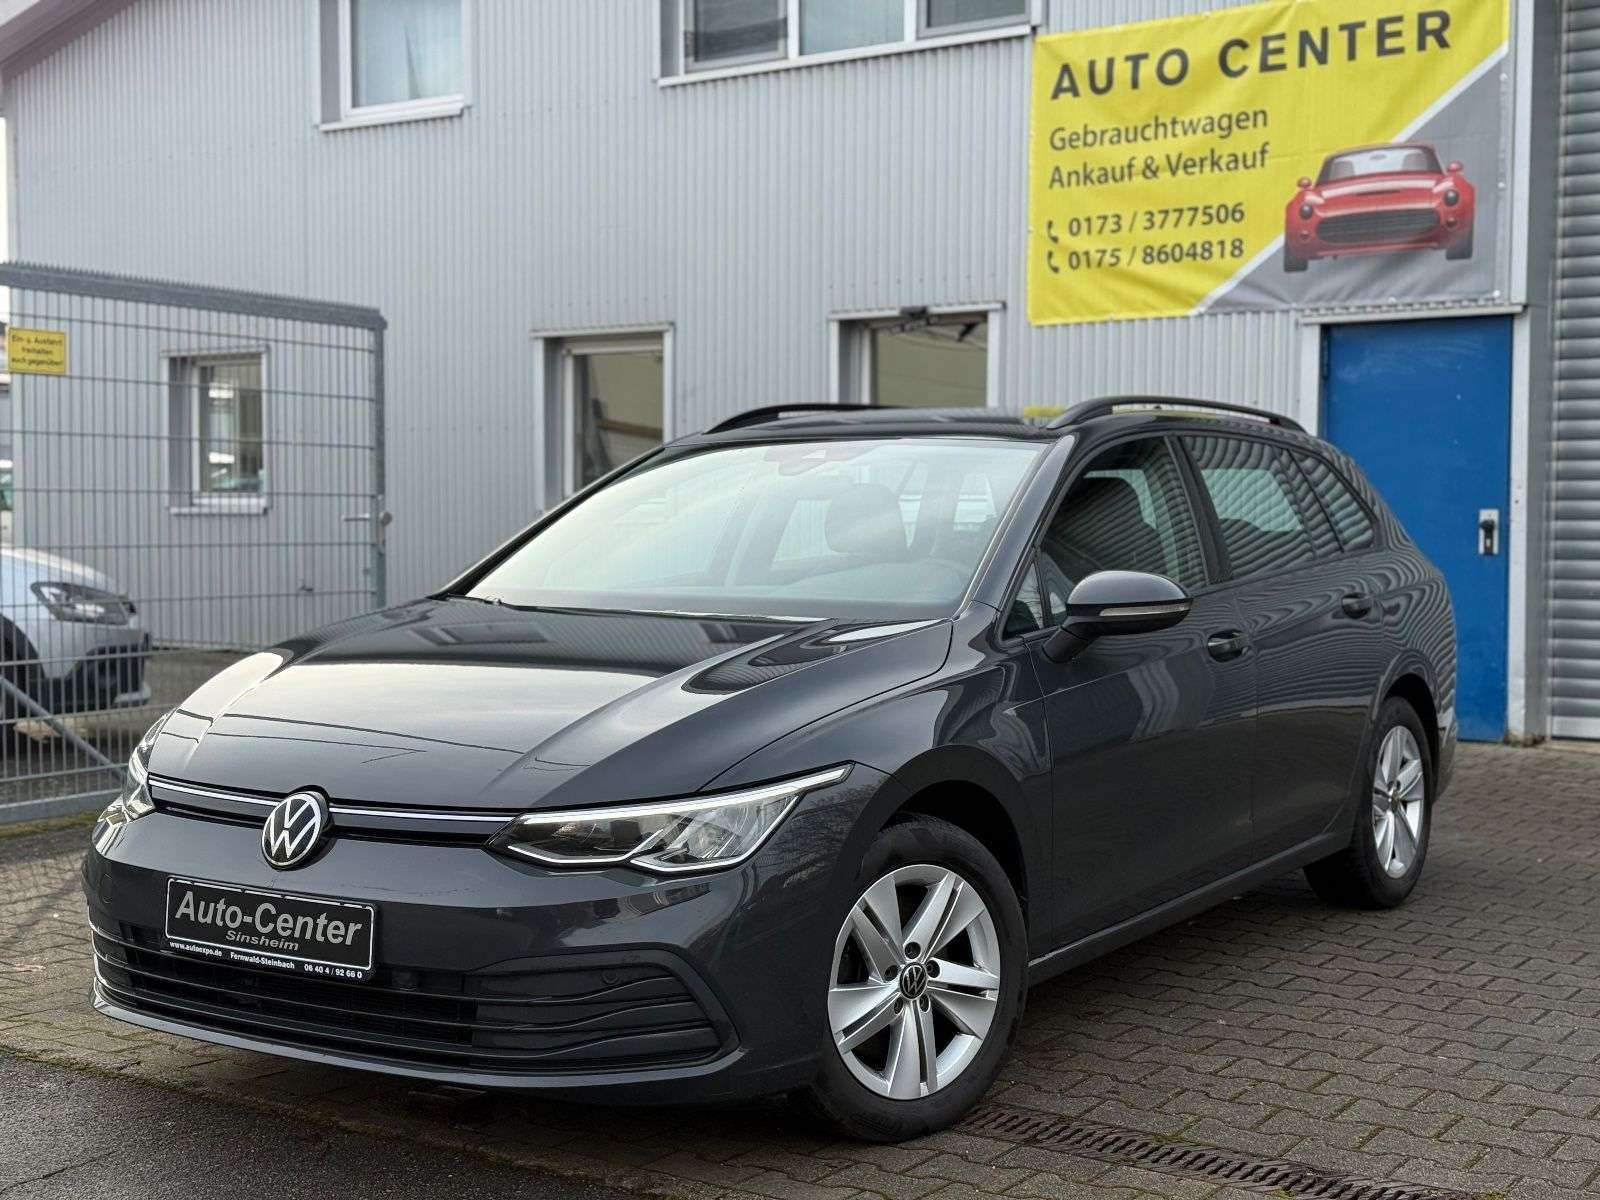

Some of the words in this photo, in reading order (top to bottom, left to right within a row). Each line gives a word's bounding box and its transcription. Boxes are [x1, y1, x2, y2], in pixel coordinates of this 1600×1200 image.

[1050, 47, 1190, 100] AUTO
[1218, 10, 1451, 80] CENTER
[1049, 109, 1268, 151] Gebrauchtwagen
[1049, 156, 1137, 189] Ankauf
[1141, 155, 1160, 180] &
[1166, 142, 1270, 177] Verkauf
[1068, 214, 1122, 237] 0173
[1143, 202, 1245, 231] 3777506
[1068, 248, 1121, 270] 0175
[1141, 238, 1244, 265] 8604818
[175, 890, 363, 946] Auto-Center
[169, 941, 222, 957] www.autoexpo.de
[230, 951, 295, 969] Fernwald-Steinbach
[225, 930, 299, 951] Sinsheim
